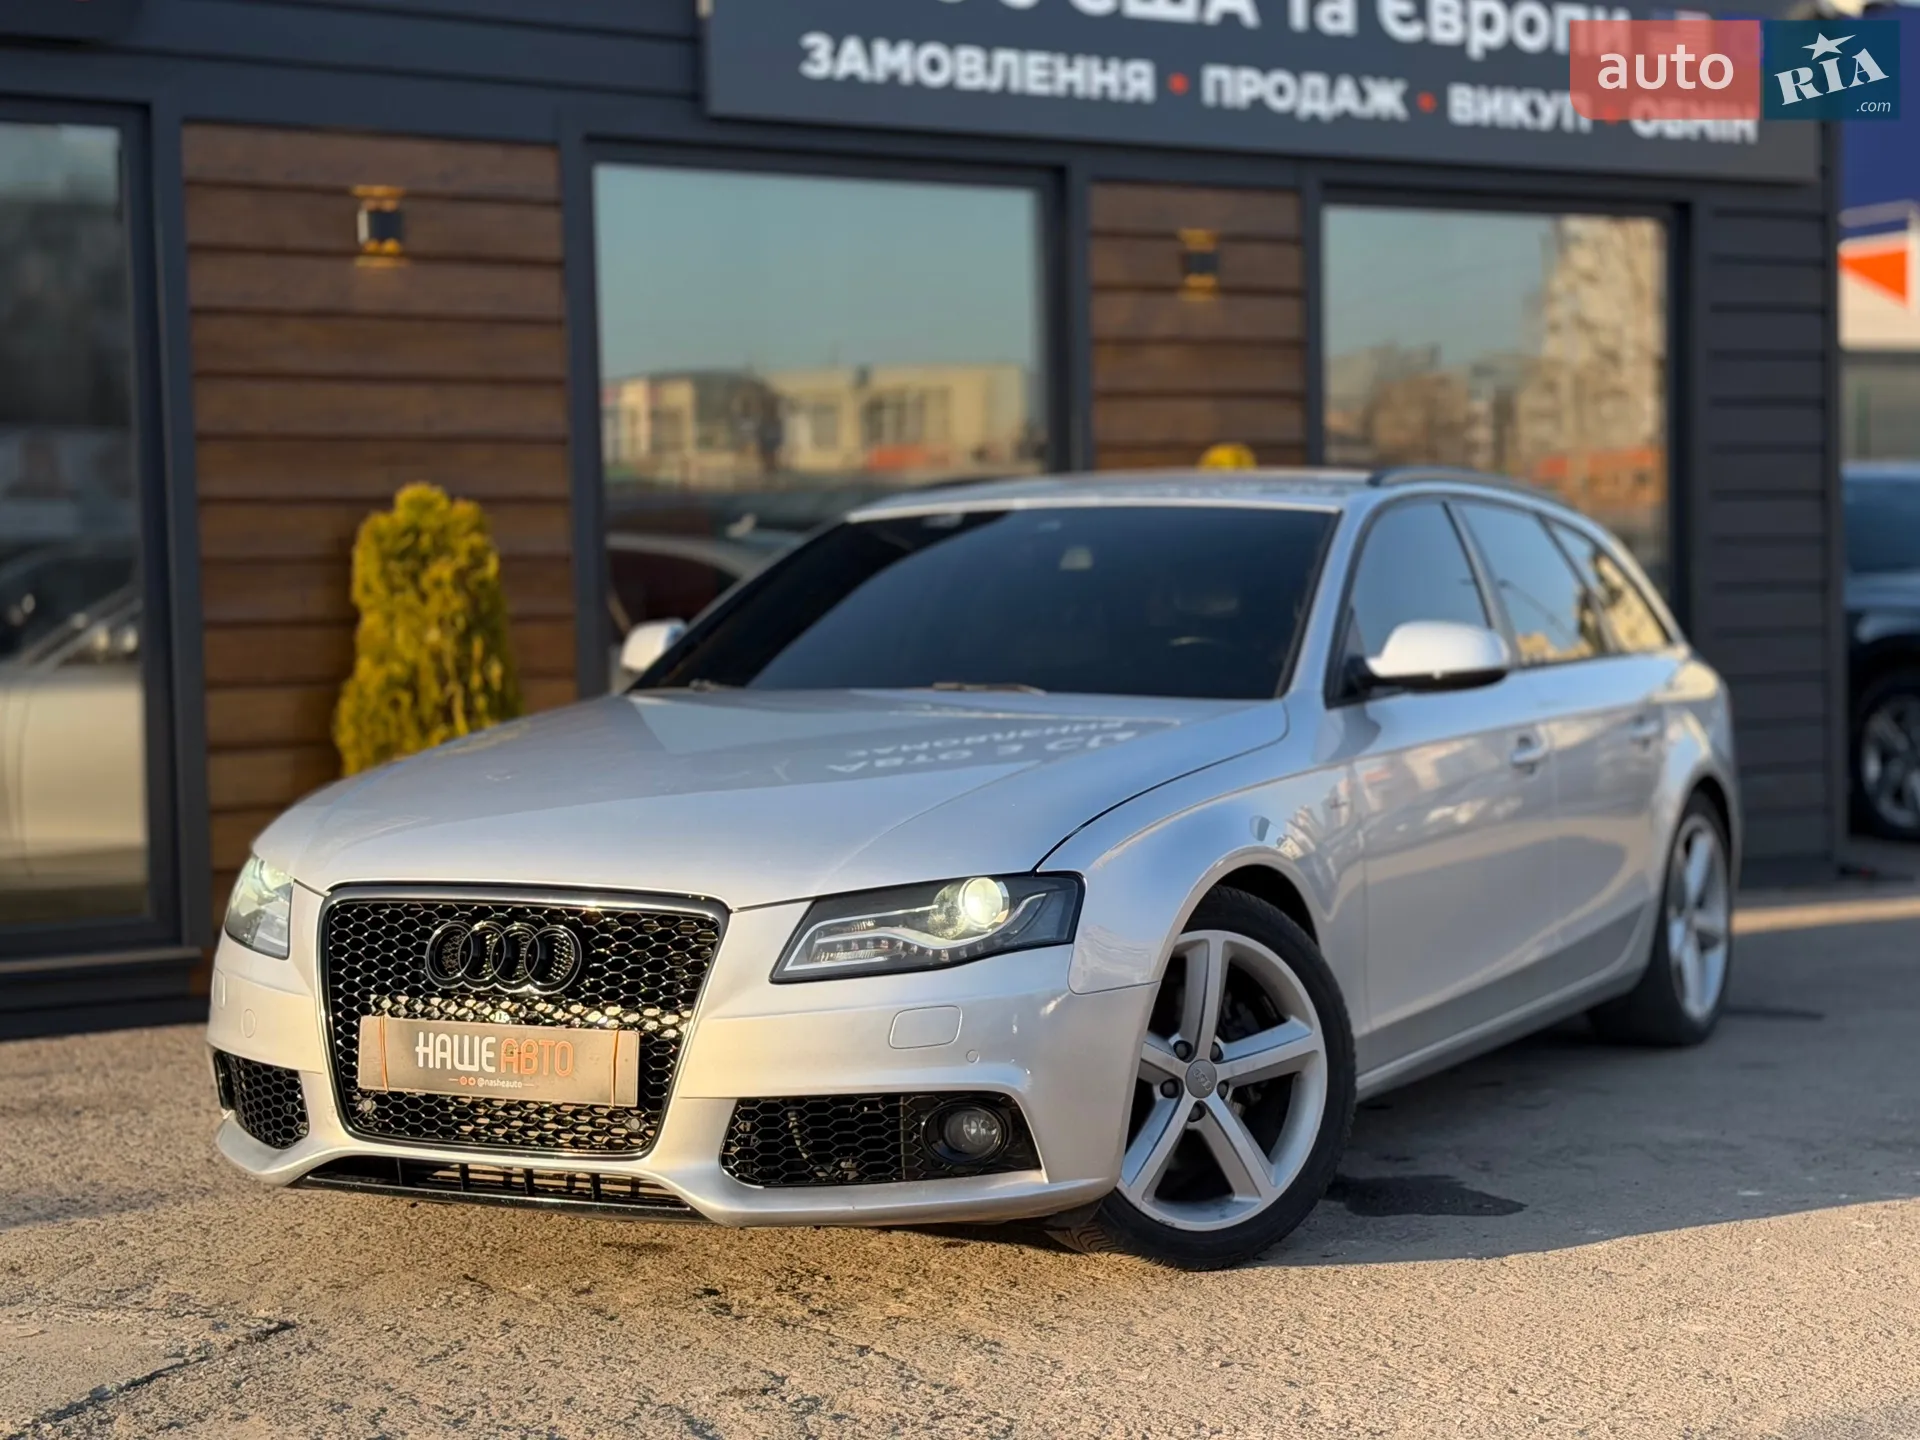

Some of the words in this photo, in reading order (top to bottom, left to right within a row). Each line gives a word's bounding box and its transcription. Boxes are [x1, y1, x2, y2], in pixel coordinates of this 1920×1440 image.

[799, 32, 1156, 103] ЗАМОВЛЕННЯ
[1201, 64, 1410, 122] ПРОДАЖ
[1447, 82, 1593, 134] ВИКУП
[415, 1031, 496, 1073] НАШЕ
[500, 1039, 575, 1077] АВТО
[477, 1078, 523, 1089] @nasheauto
